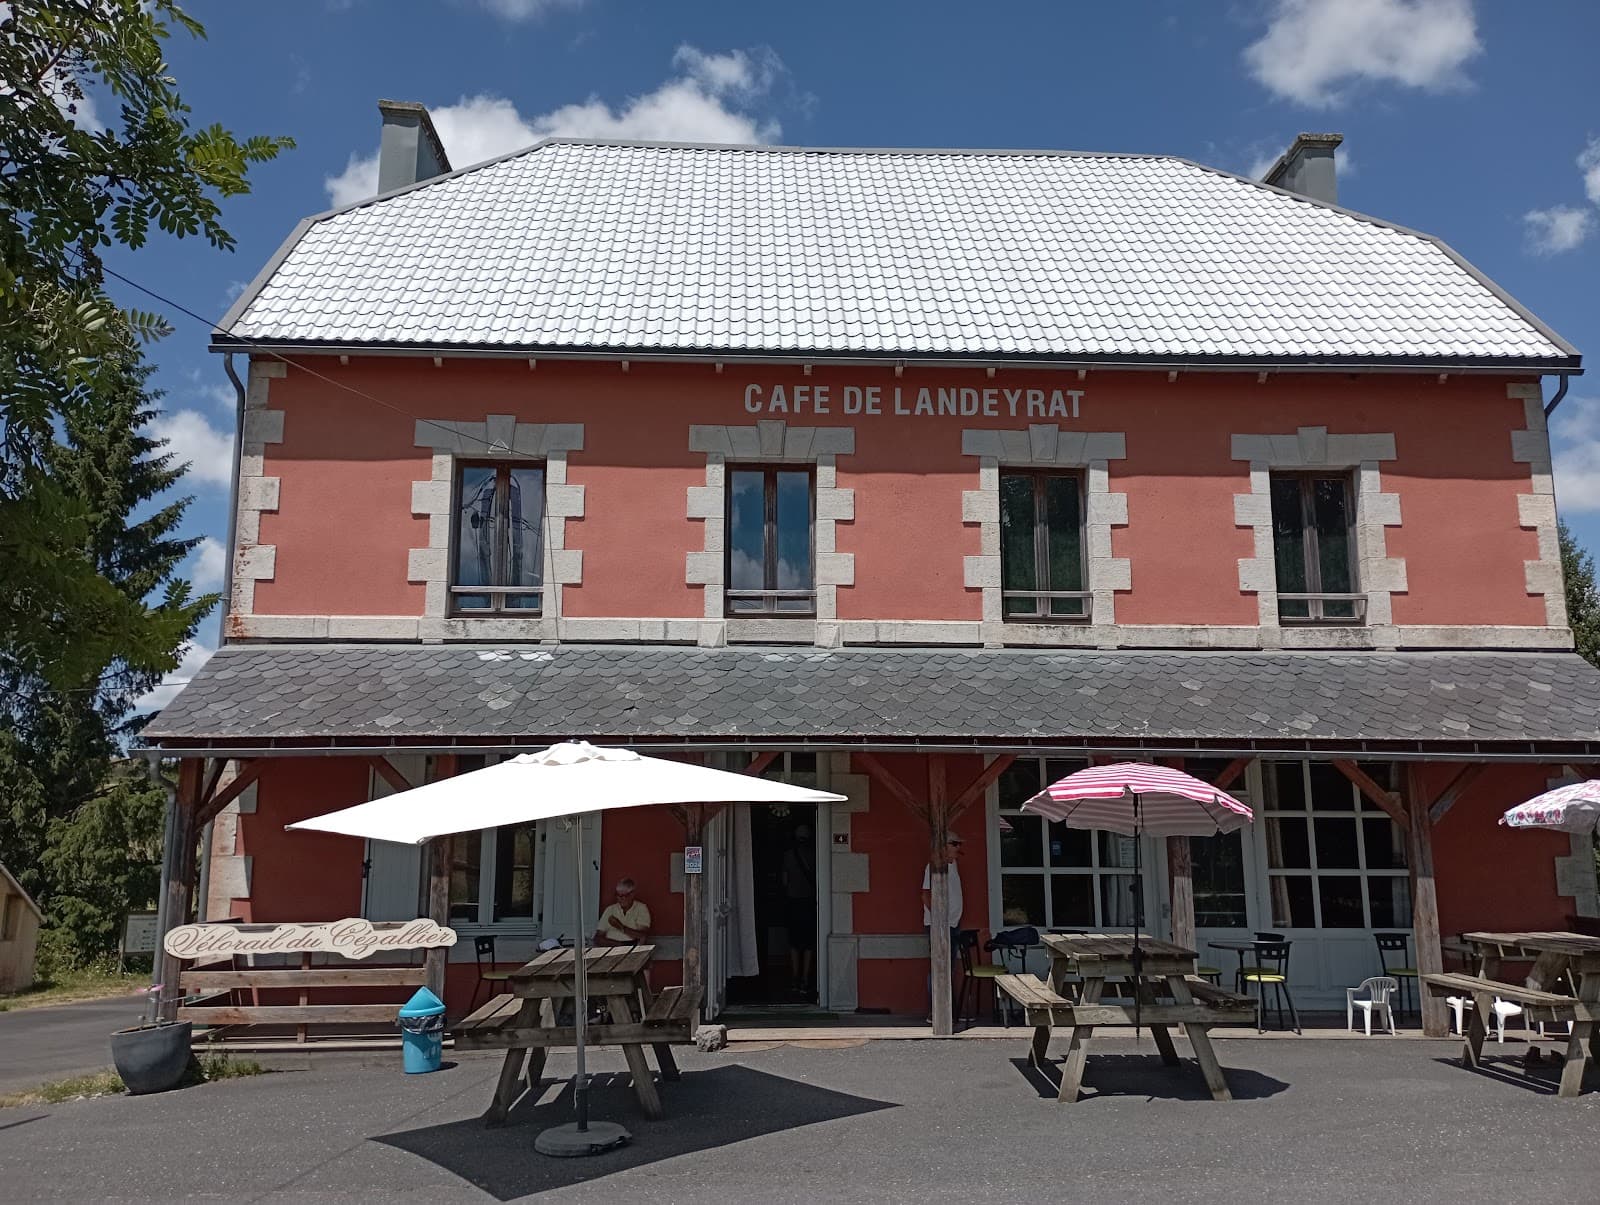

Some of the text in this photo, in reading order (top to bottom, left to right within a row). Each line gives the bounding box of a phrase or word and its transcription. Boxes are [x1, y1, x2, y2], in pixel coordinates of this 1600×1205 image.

[744, 383, 1085, 418] CAFE DE LANDEYRAT
[168, 927, 296, 956] Vélorail
[286, 930, 322, 949] du
[330, 921, 453, 955] Cézallier
